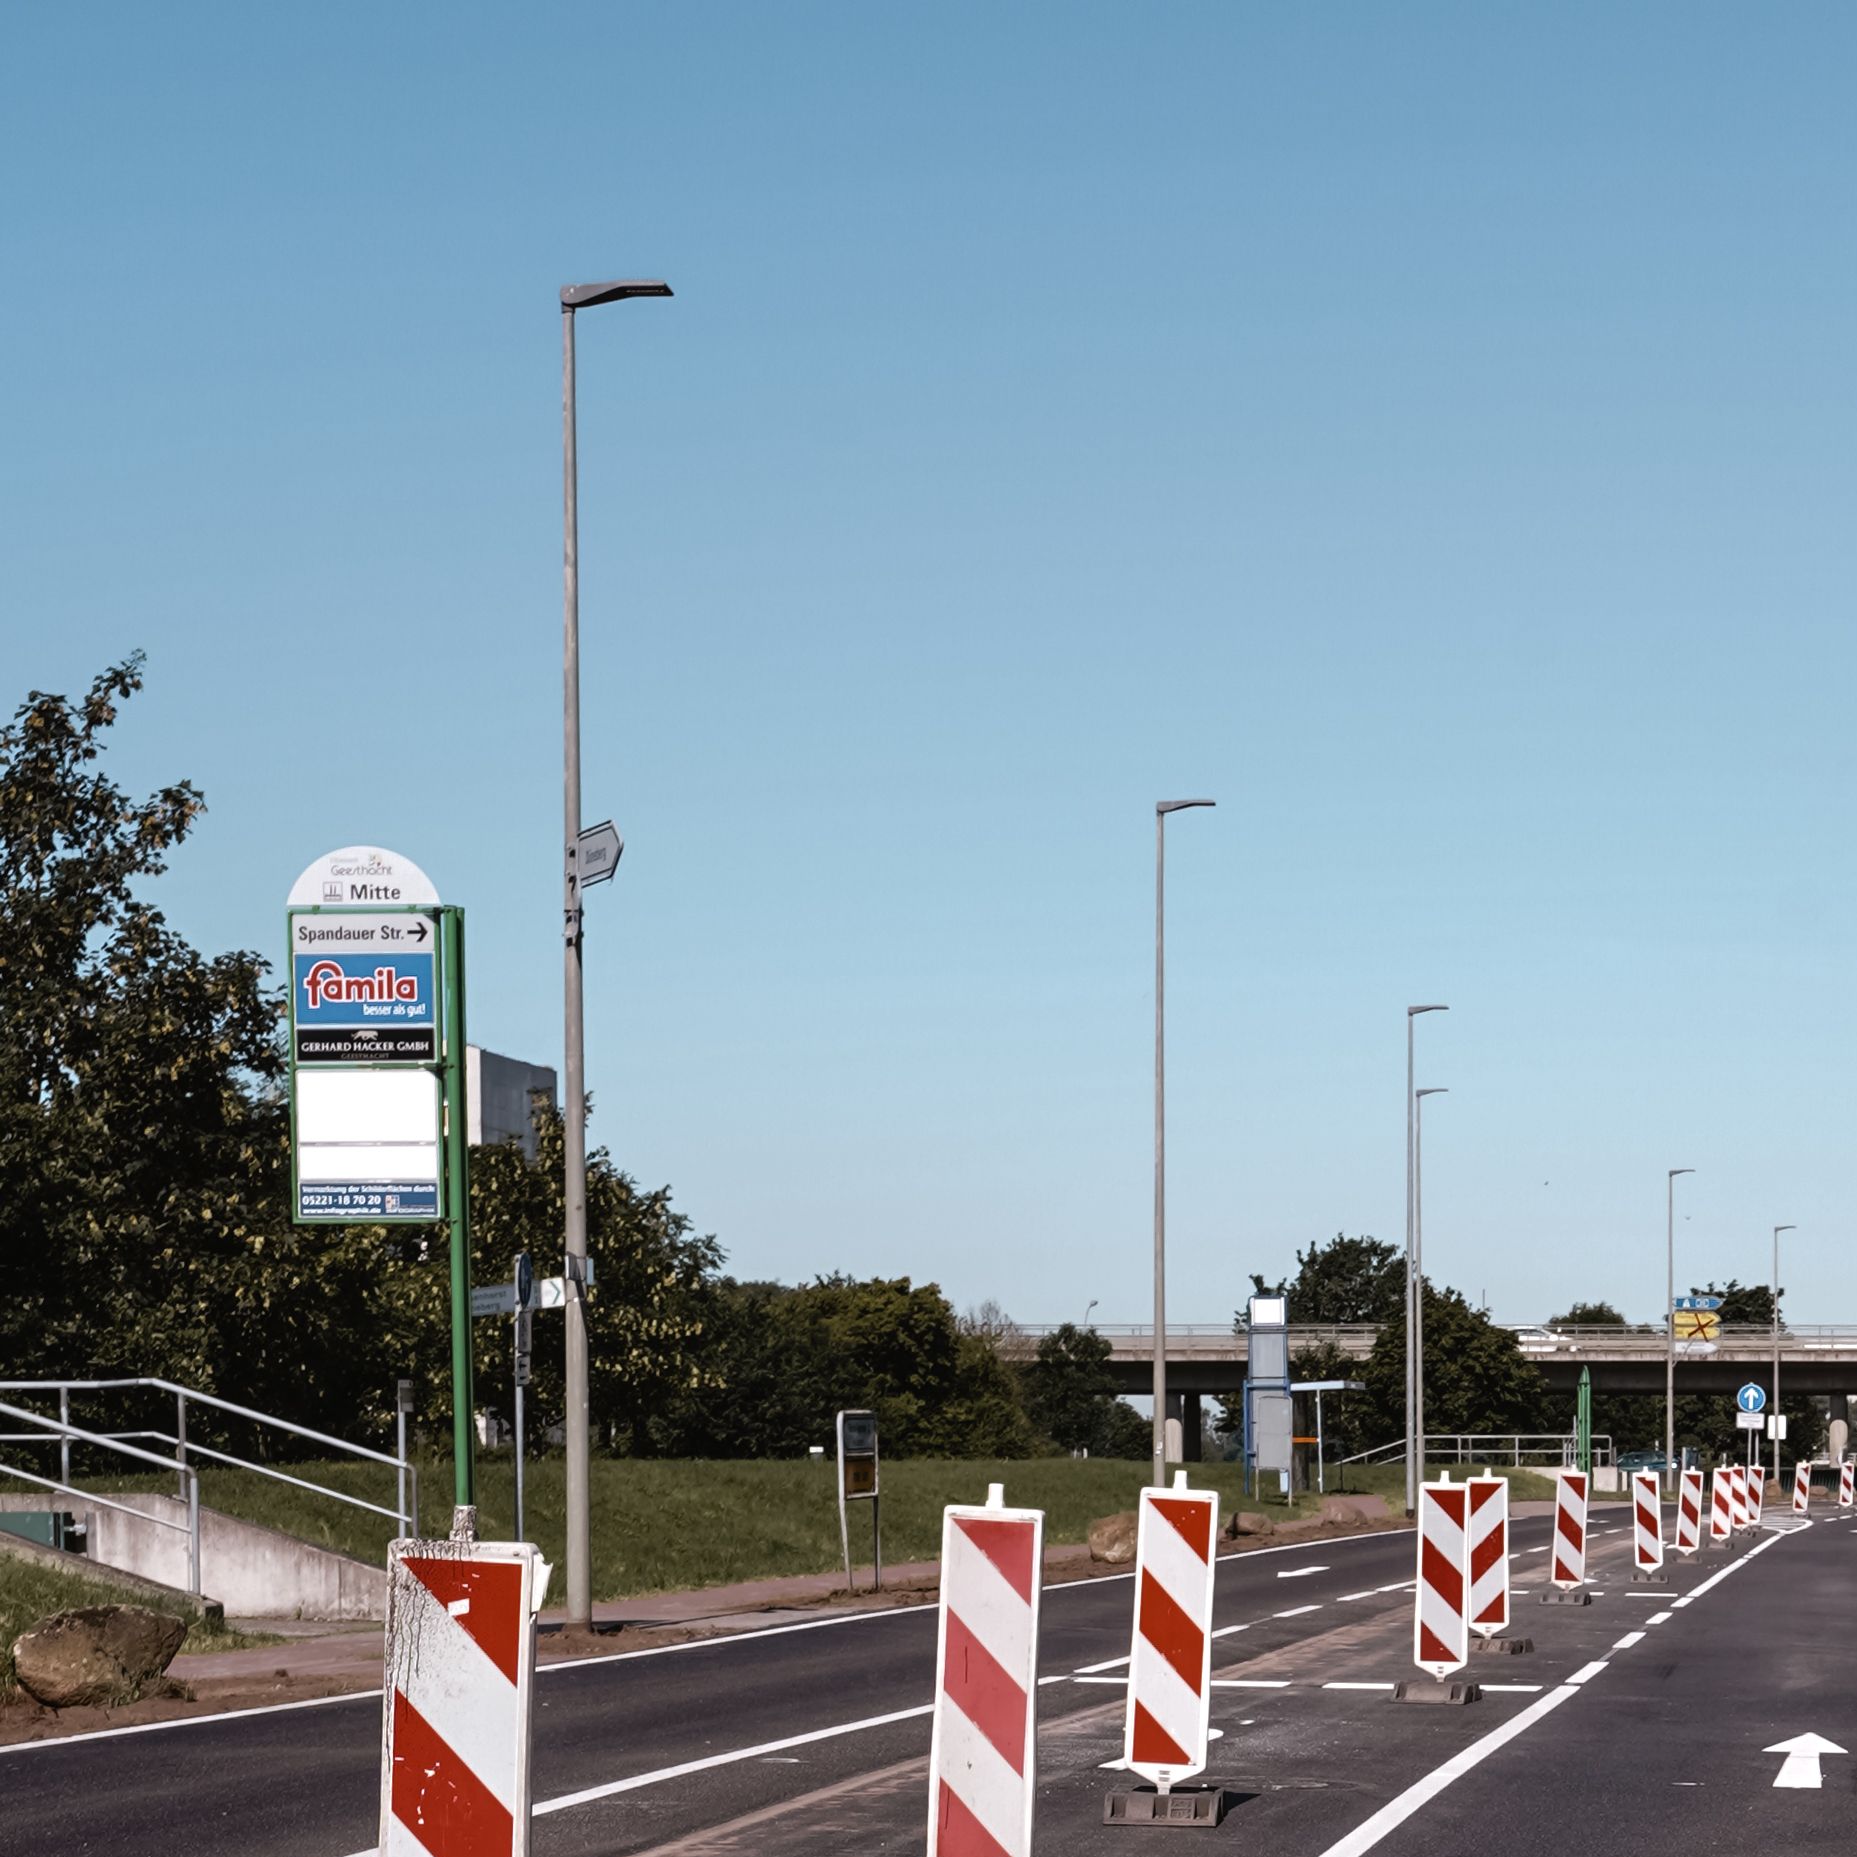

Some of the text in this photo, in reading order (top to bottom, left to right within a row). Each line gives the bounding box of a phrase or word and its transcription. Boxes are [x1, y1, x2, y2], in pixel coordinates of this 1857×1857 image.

[350, 884, 401, 900] Mitte
[298, 924, 405, 944] Spandauer Str.
[305, 961, 416, 1008] famila
[393, 1003, 406, 1015] als
[407, 1003, 426, 1018] gut!
[301, 1041, 430, 1052] GERHARD HACKER GMBH
[302, 1194, 382, 1206] 05221-18 70 20
